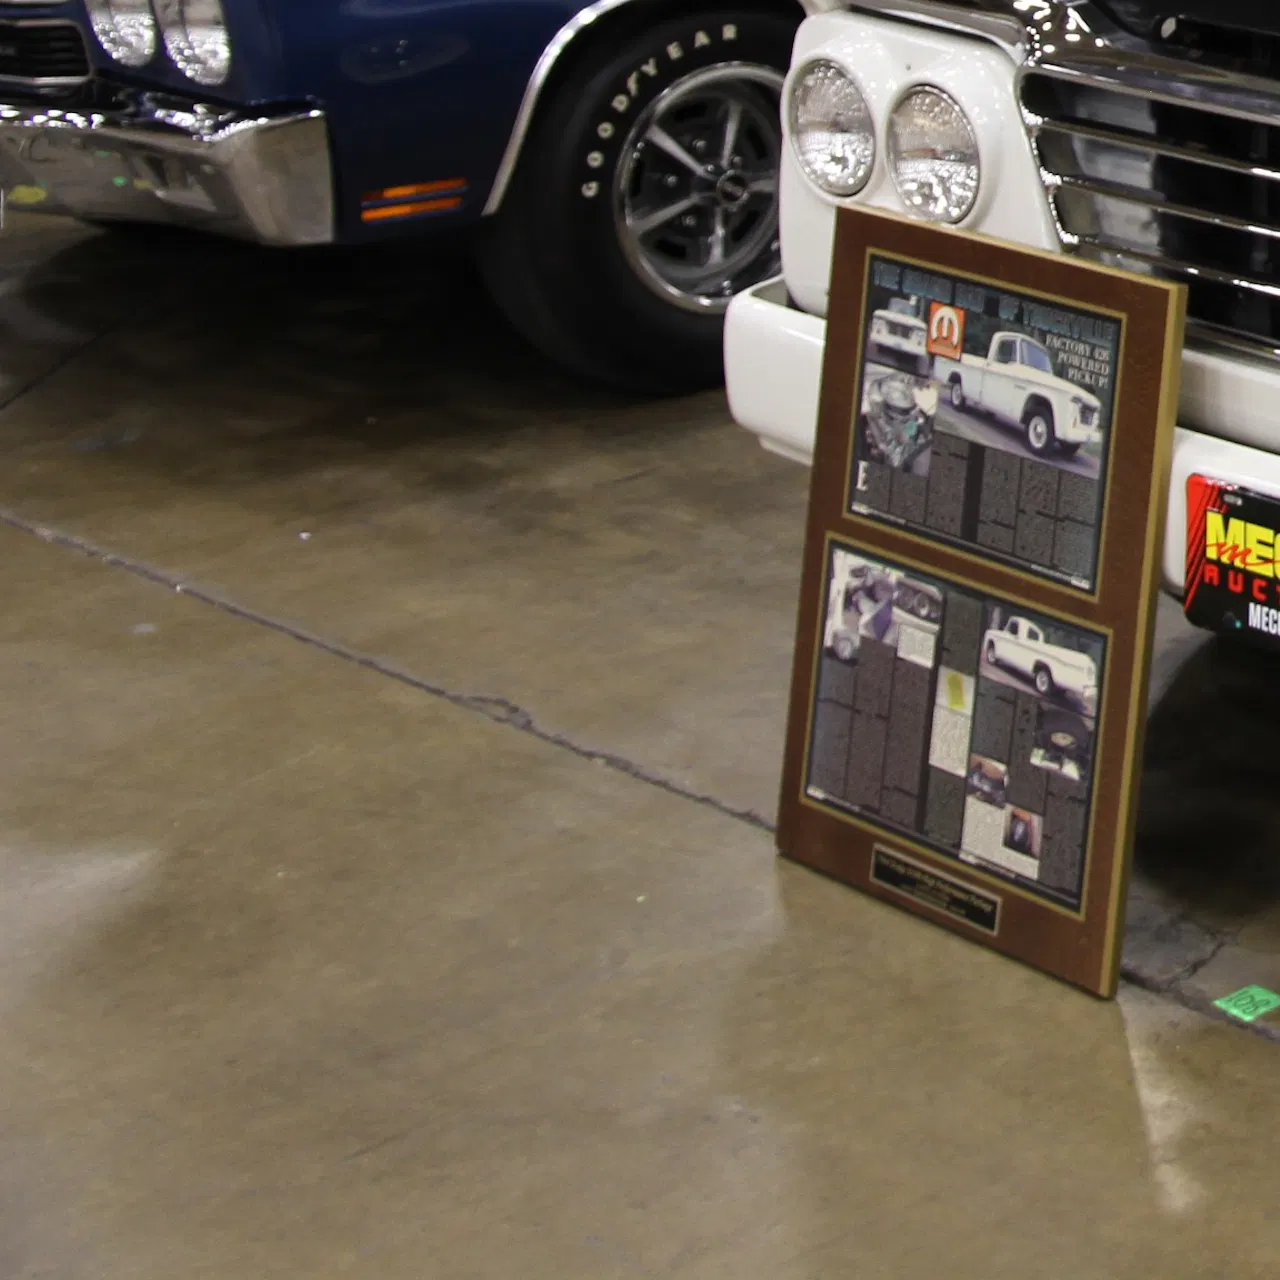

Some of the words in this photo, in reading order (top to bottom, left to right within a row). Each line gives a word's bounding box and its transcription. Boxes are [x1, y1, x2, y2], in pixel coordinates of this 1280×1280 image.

[581, 23, 738, 199] GOODYEAR
[1045, 333, 1091, 356] FACTORY
[1057, 351, 1109, 375] POWERED
[1068, 368, 1109, 389] PICKUP!
